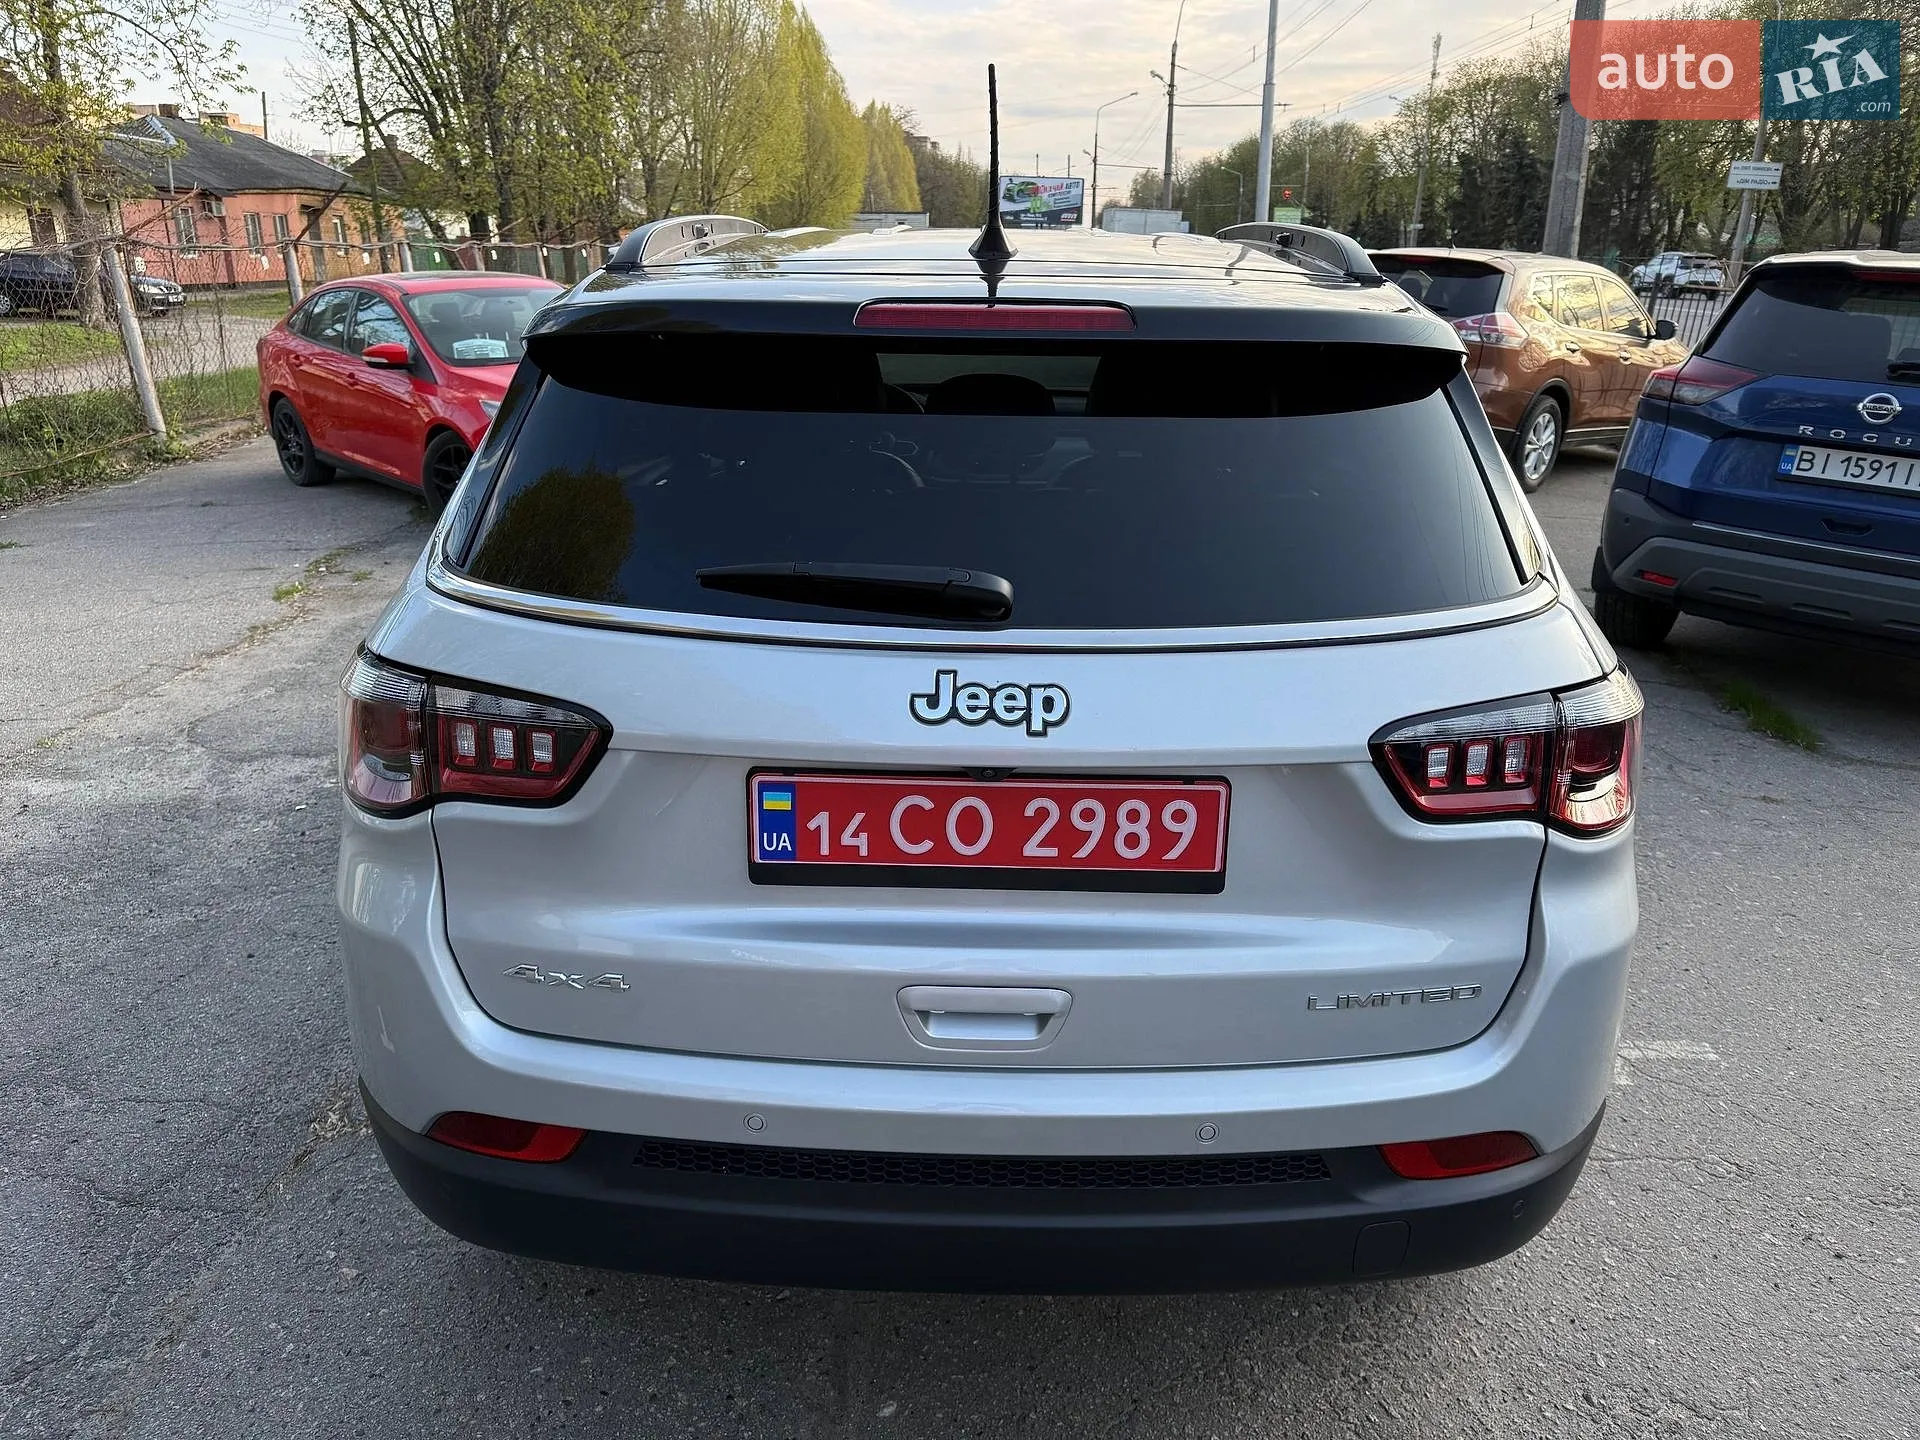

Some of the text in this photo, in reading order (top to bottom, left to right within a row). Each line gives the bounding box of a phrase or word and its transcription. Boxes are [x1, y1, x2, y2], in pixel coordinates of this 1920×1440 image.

[1862, 404, 1897, 414] NISSAN
[1781, 462, 1792, 471] UA
[1840, 455, 1898, 483] 1591
[910, 669, 1071, 737] Jeep
[806, 795, 1198, 860] 14 CO 2989
[763, 833, 792, 852] UA
[1307, 983, 1482, 1011] LIMITED
